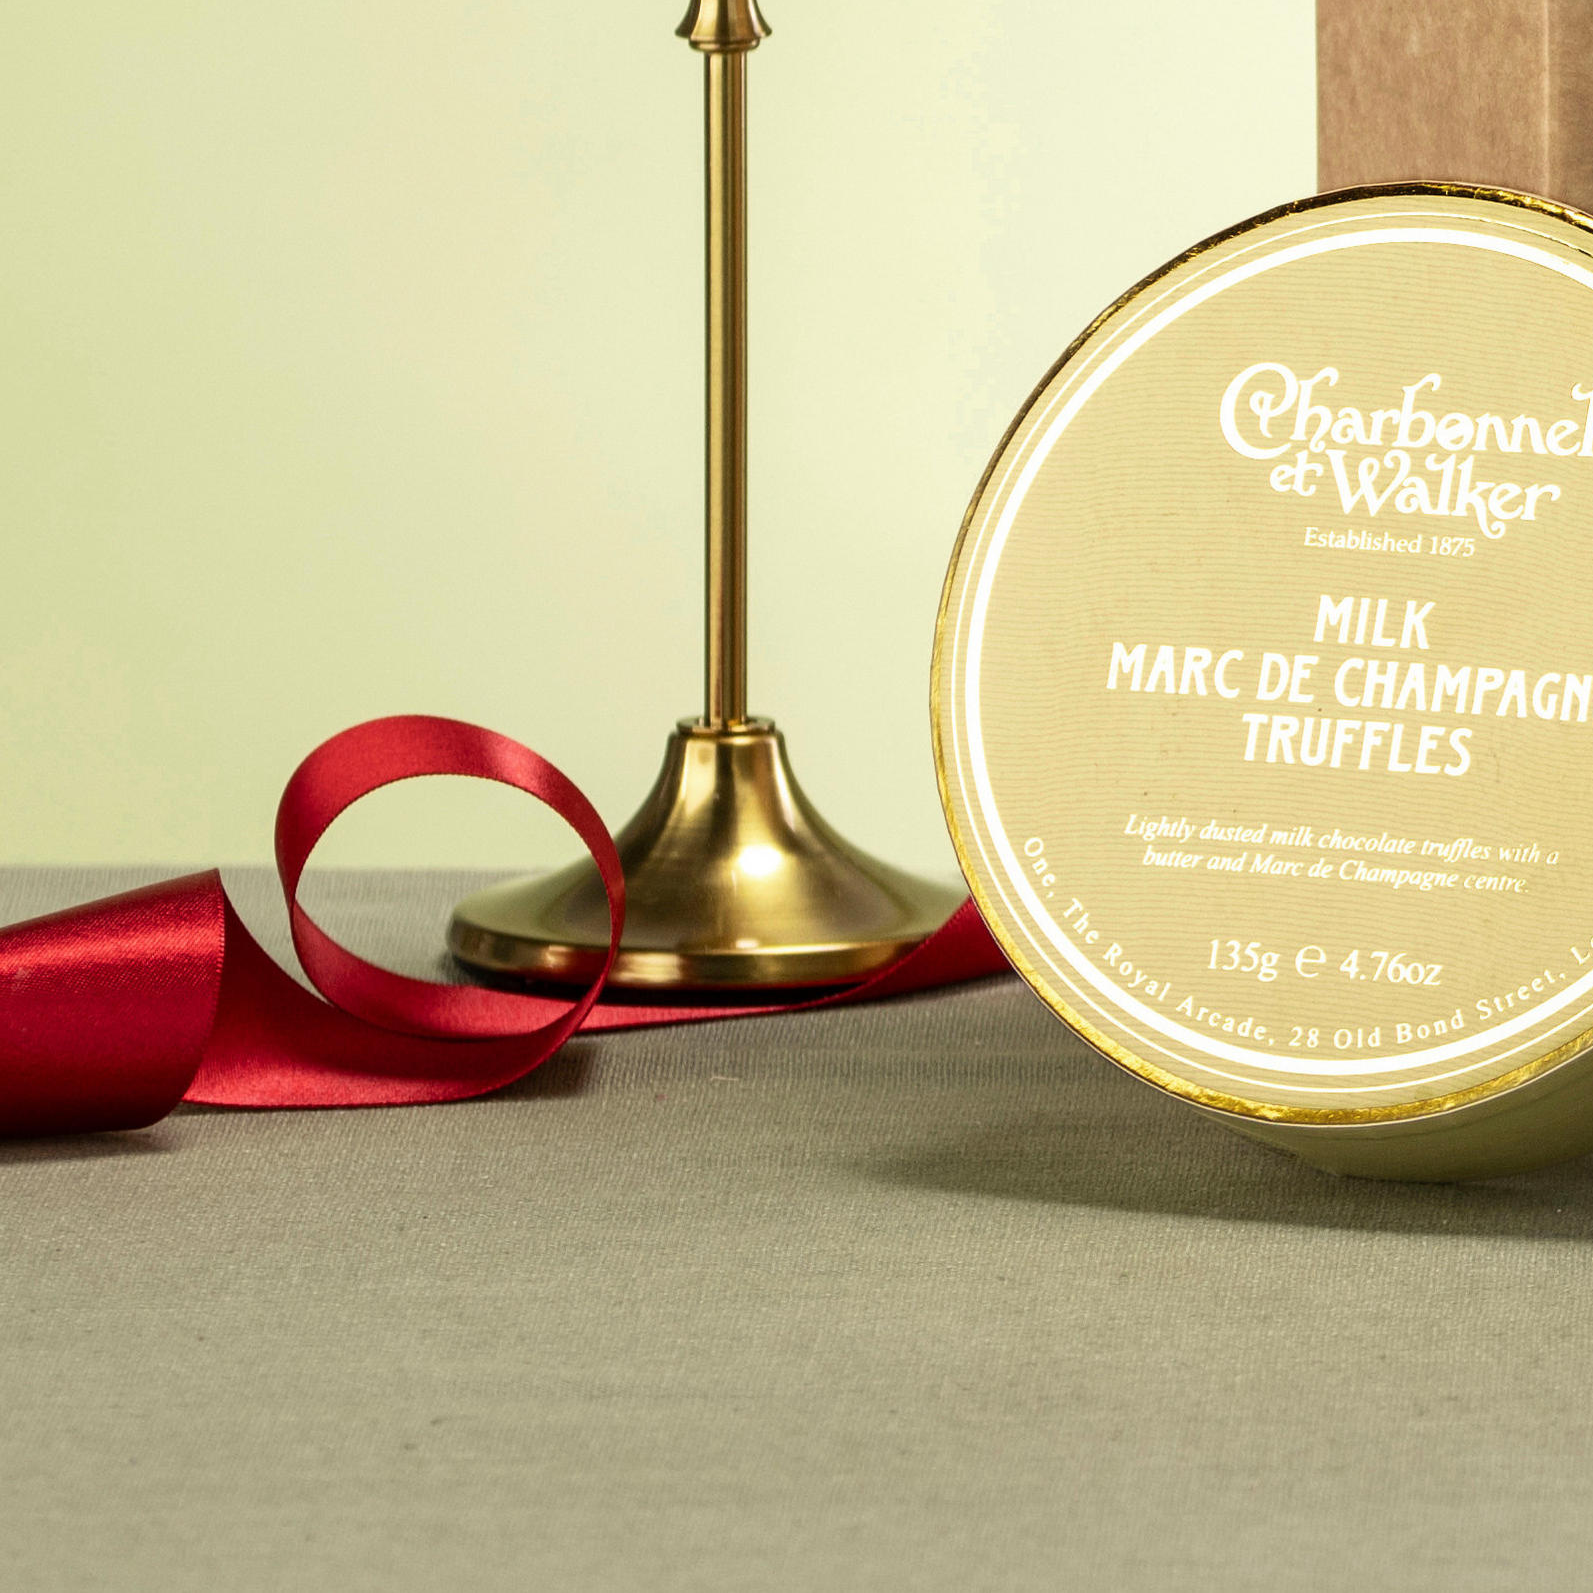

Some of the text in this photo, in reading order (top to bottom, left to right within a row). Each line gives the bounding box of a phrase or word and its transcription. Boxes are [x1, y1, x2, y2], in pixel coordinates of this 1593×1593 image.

[1324, 448, 1560, 539] Walker
[1304, 527, 1475, 557] Established 1875
[1313, 594, 1436, 650] MILK
[1106, 642, 1245, 700] MARC
[1256, 652, 1318, 704] DE
[1242, 713, 1473, 776] TRUFFLES
[1125, 814, 1559, 864] Lightly dusted milk chocolate truffles with a
[1143, 844, 1529, 893] butter and Marc de Champagne centre.
[1023, 836, 1054, 897] One,
[1062, 899, 1099, 946] The
[1102, 942, 1171, 1002] Royal
[1175, 995, 1275, 1047] Arcade,
[1289, 1026, 1320, 1049] 28
[1333, 1027, 1381, 1050] Old
[1395, 1010, 1465, 1045] Bond
[1475, 968, 1566, 1021] Street,
[1207, 937, 1279, 982] 135g
[1339, 950, 1442, 986] 4.76oz
